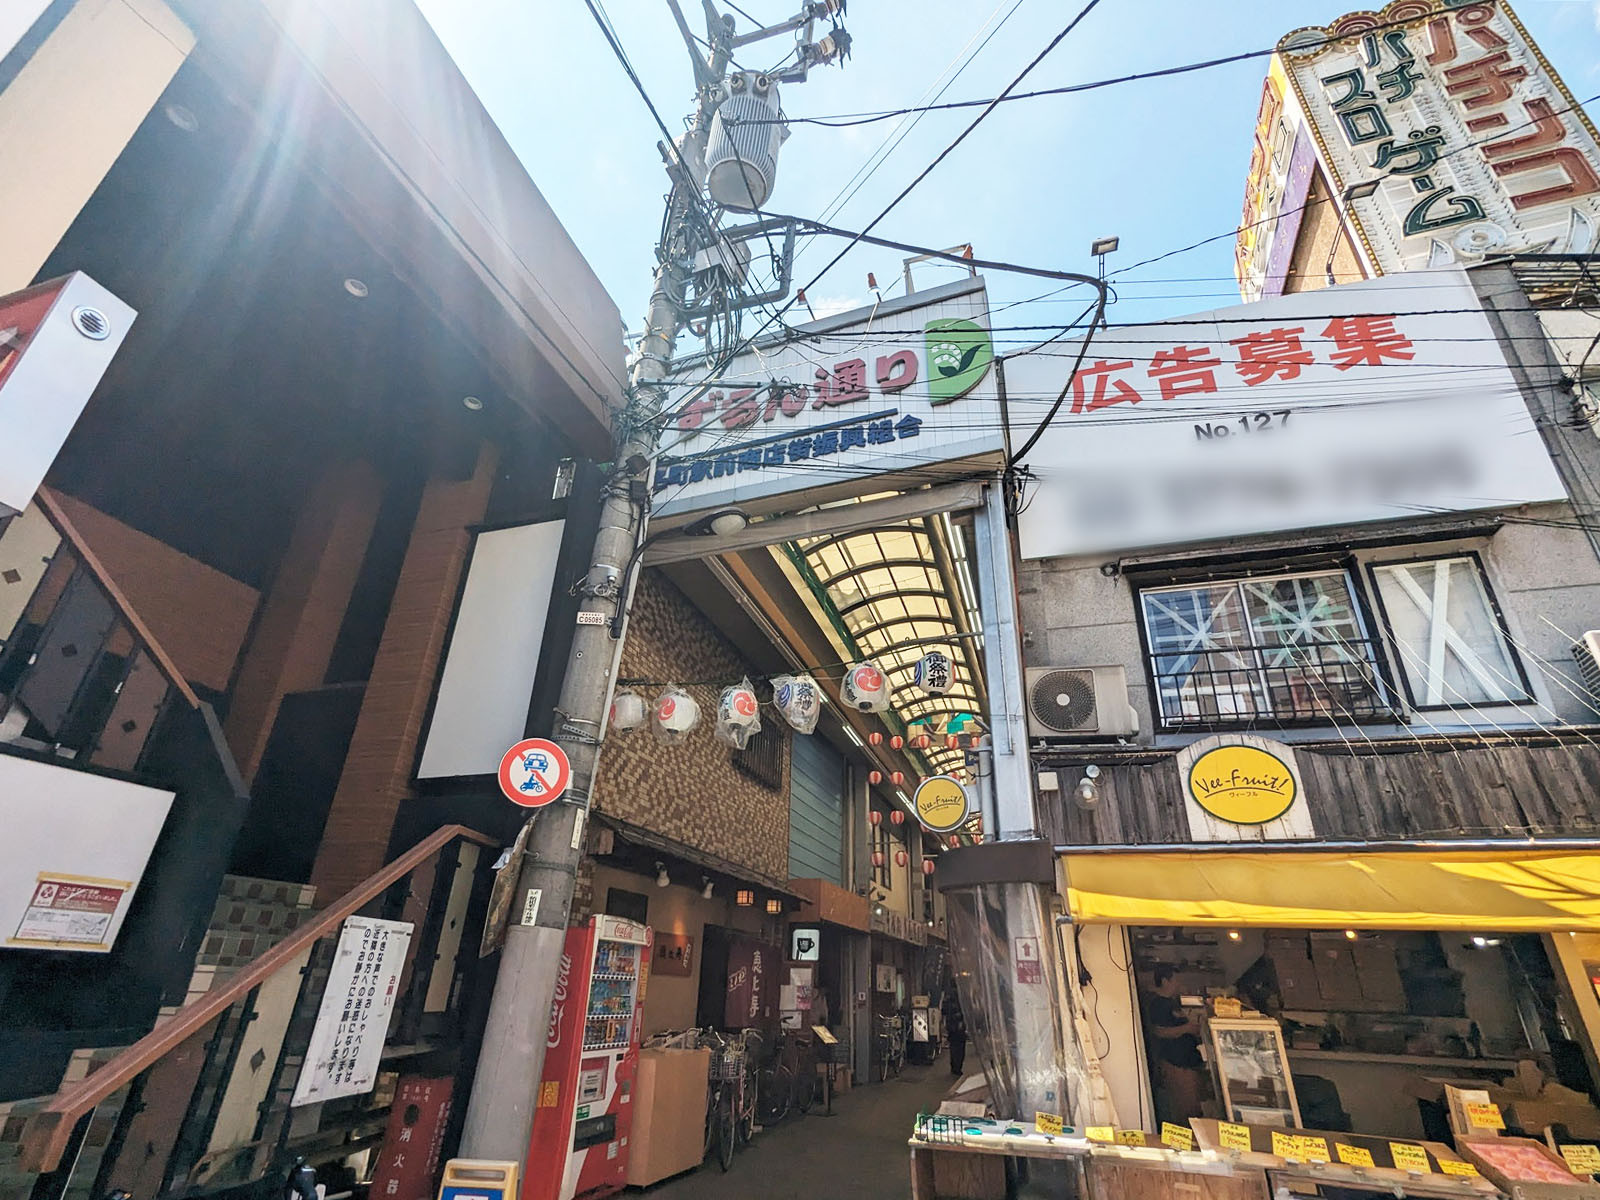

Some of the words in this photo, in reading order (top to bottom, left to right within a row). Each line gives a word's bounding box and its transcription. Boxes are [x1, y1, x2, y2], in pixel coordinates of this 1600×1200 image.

[1424, 4, 1600, 212] パチンコ
[1069, 313, 1416, 414] 広告募集
[1194, 410, 1293, 441] No.127
[1195, 769, 1290, 793] Vee-Fruit!
